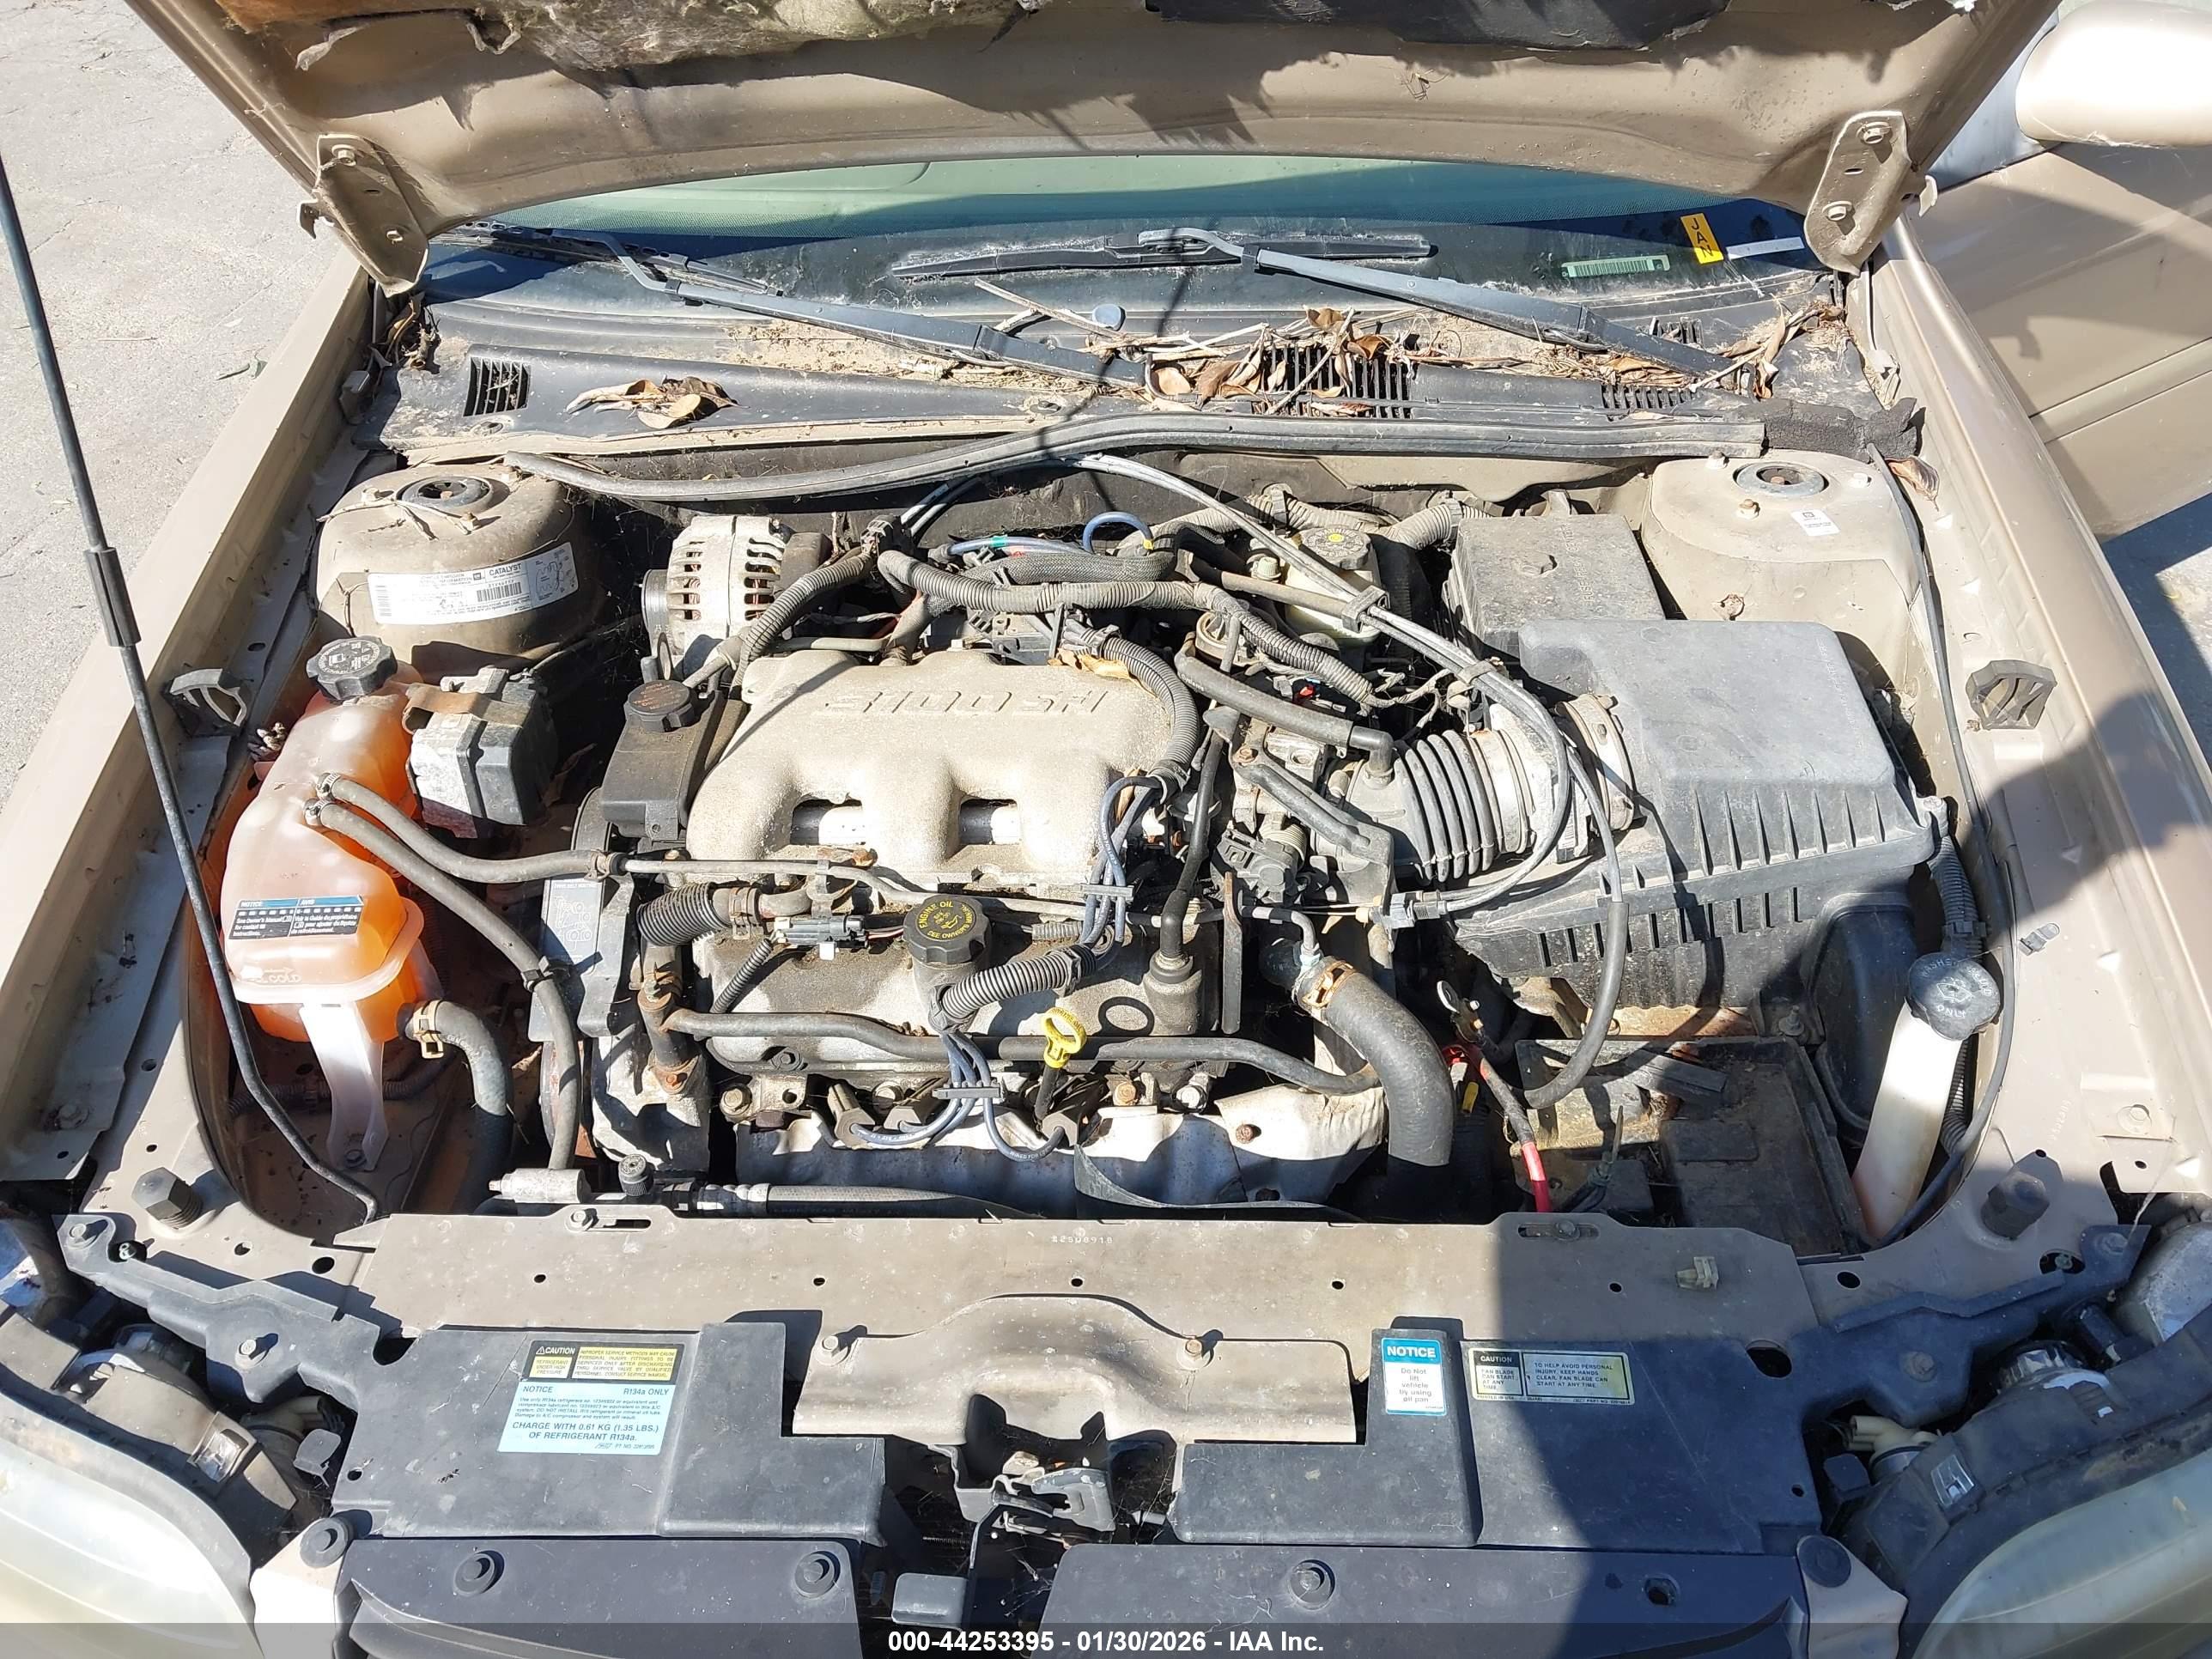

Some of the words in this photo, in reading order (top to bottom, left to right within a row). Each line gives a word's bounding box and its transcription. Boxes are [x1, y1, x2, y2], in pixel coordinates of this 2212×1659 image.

[1691, 217, 1713, 258] JAN
[489, 563, 522, 576] CATALYST
[918, 902, 939, 929] ENGINE
[545, 1347, 575, 1355] CAUTION
[1386, 1346, 1436, 1358] NOTICE
[636, 1425, 659, 1433] LBS.)
[544, 1432, 608, 1440] REFRIGERANT
